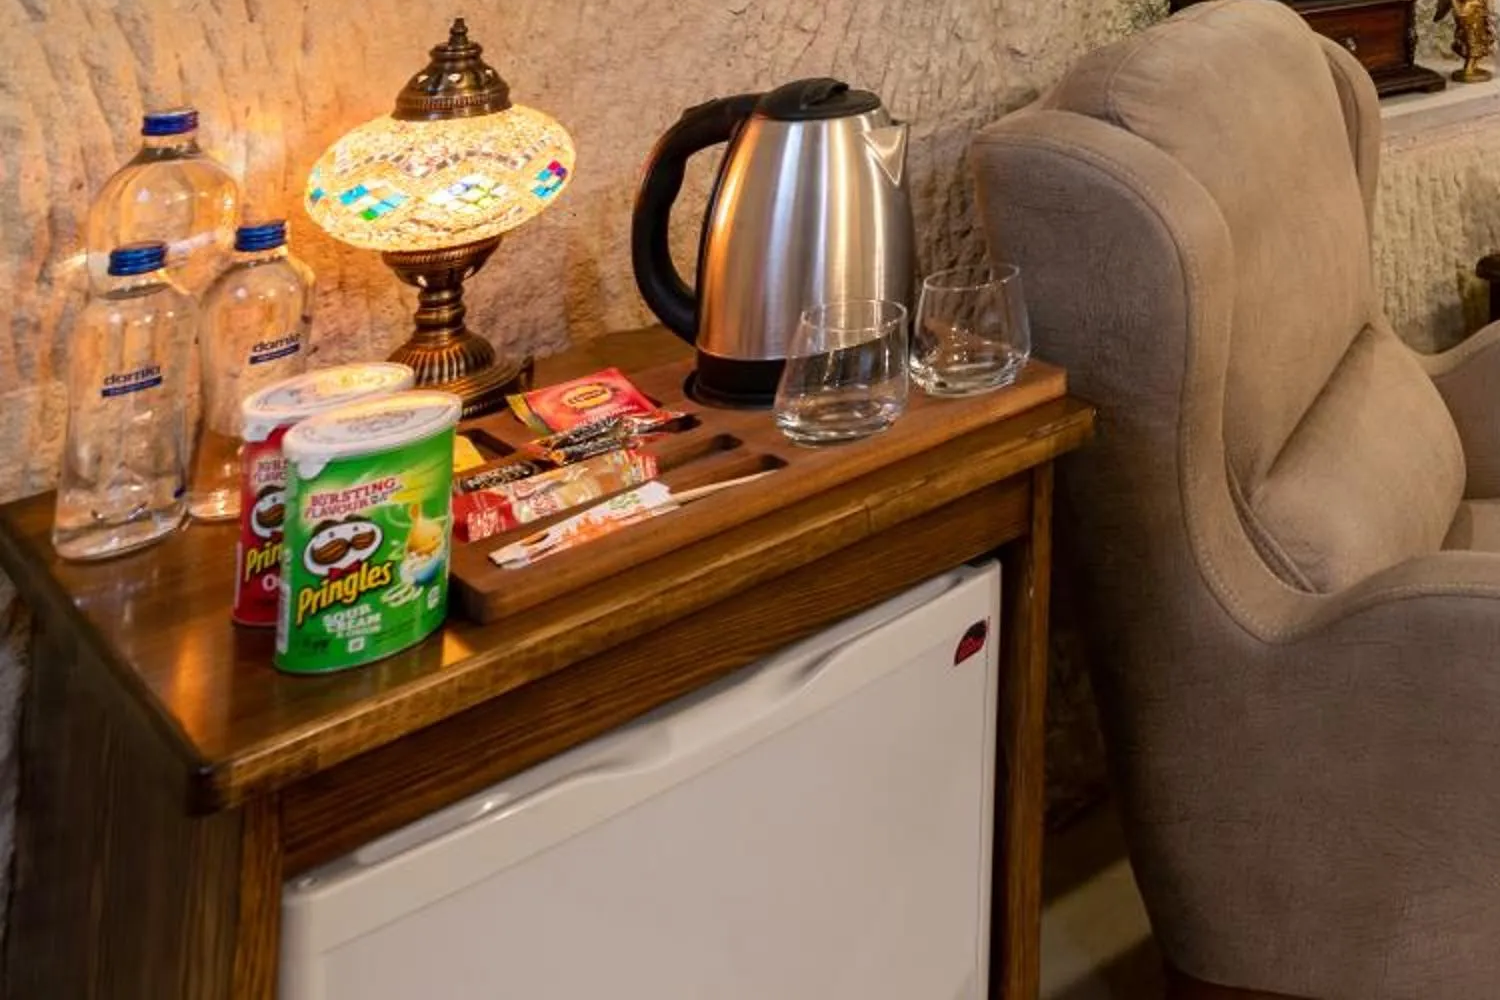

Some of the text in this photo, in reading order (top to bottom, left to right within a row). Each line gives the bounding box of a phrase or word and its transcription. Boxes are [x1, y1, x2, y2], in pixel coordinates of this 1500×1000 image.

[311, 477, 396, 507] BURSTING
[244, 541, 286, 583] Prin
[296, 562, 392, 628] Pringles
